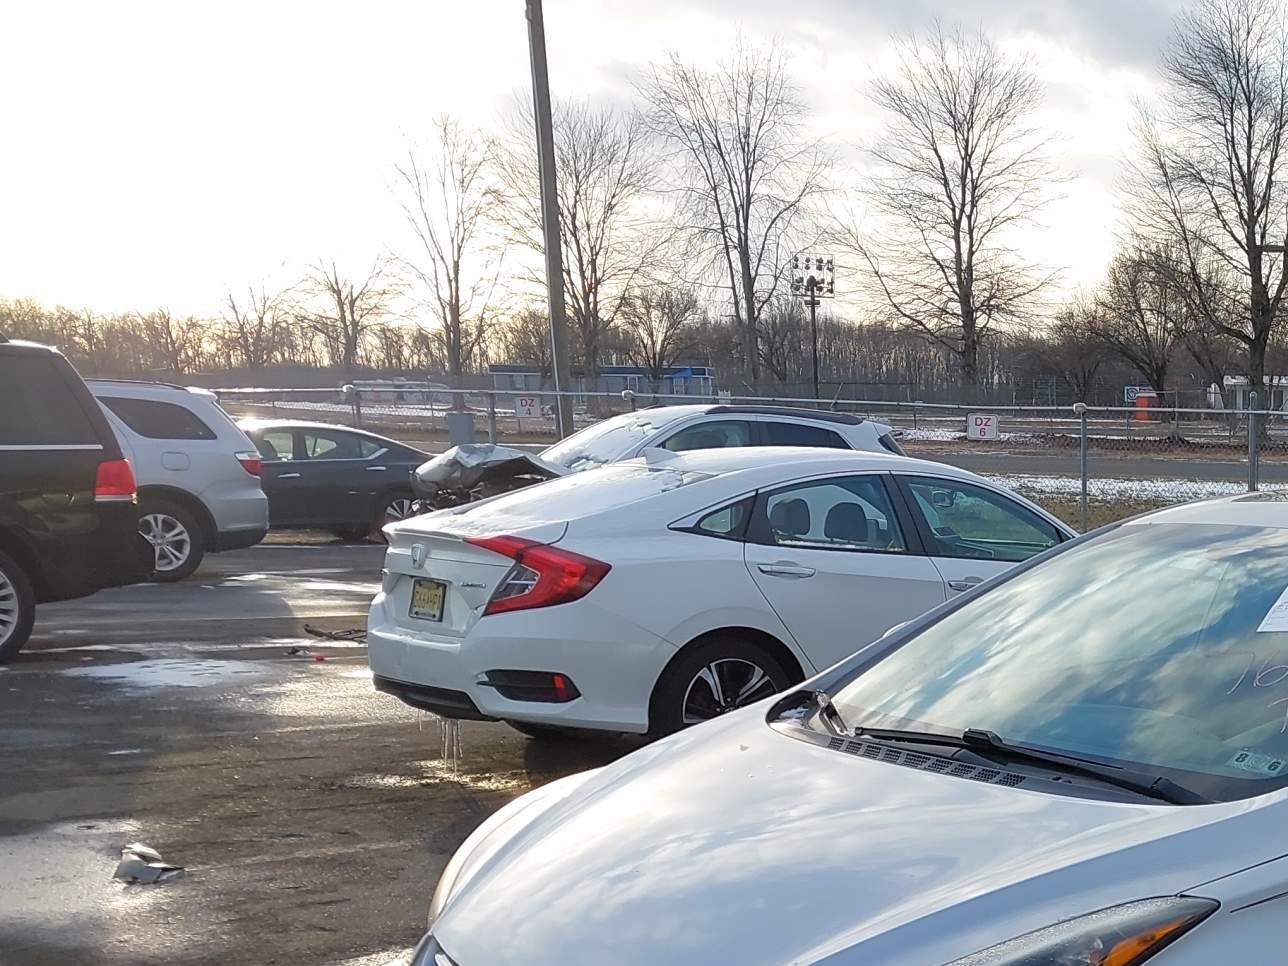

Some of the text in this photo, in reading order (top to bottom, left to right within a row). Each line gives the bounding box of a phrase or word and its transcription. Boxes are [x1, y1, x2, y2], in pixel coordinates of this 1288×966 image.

[520, 398, 535, 408] DZ
[975, 417, 992, 427] DZ
[979, 428, 986, 437] 6
